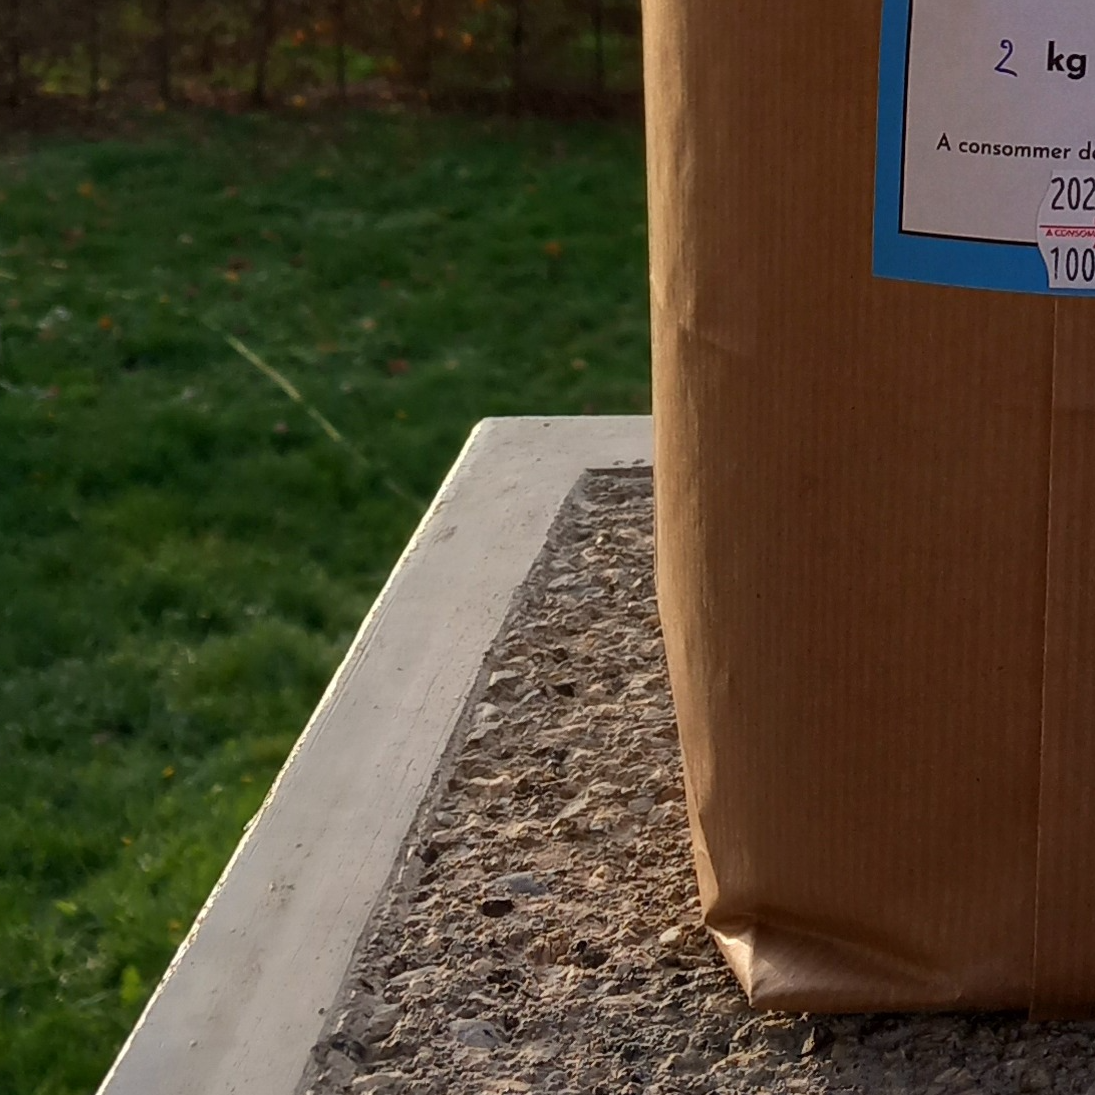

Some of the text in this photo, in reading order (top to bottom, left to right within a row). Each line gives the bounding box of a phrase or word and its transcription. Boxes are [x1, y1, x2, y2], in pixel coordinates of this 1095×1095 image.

[994, 39, 1087, 80] 2 kg
[936, 132, 951, 151] A
[958, 141, 1071, 159] consommer
